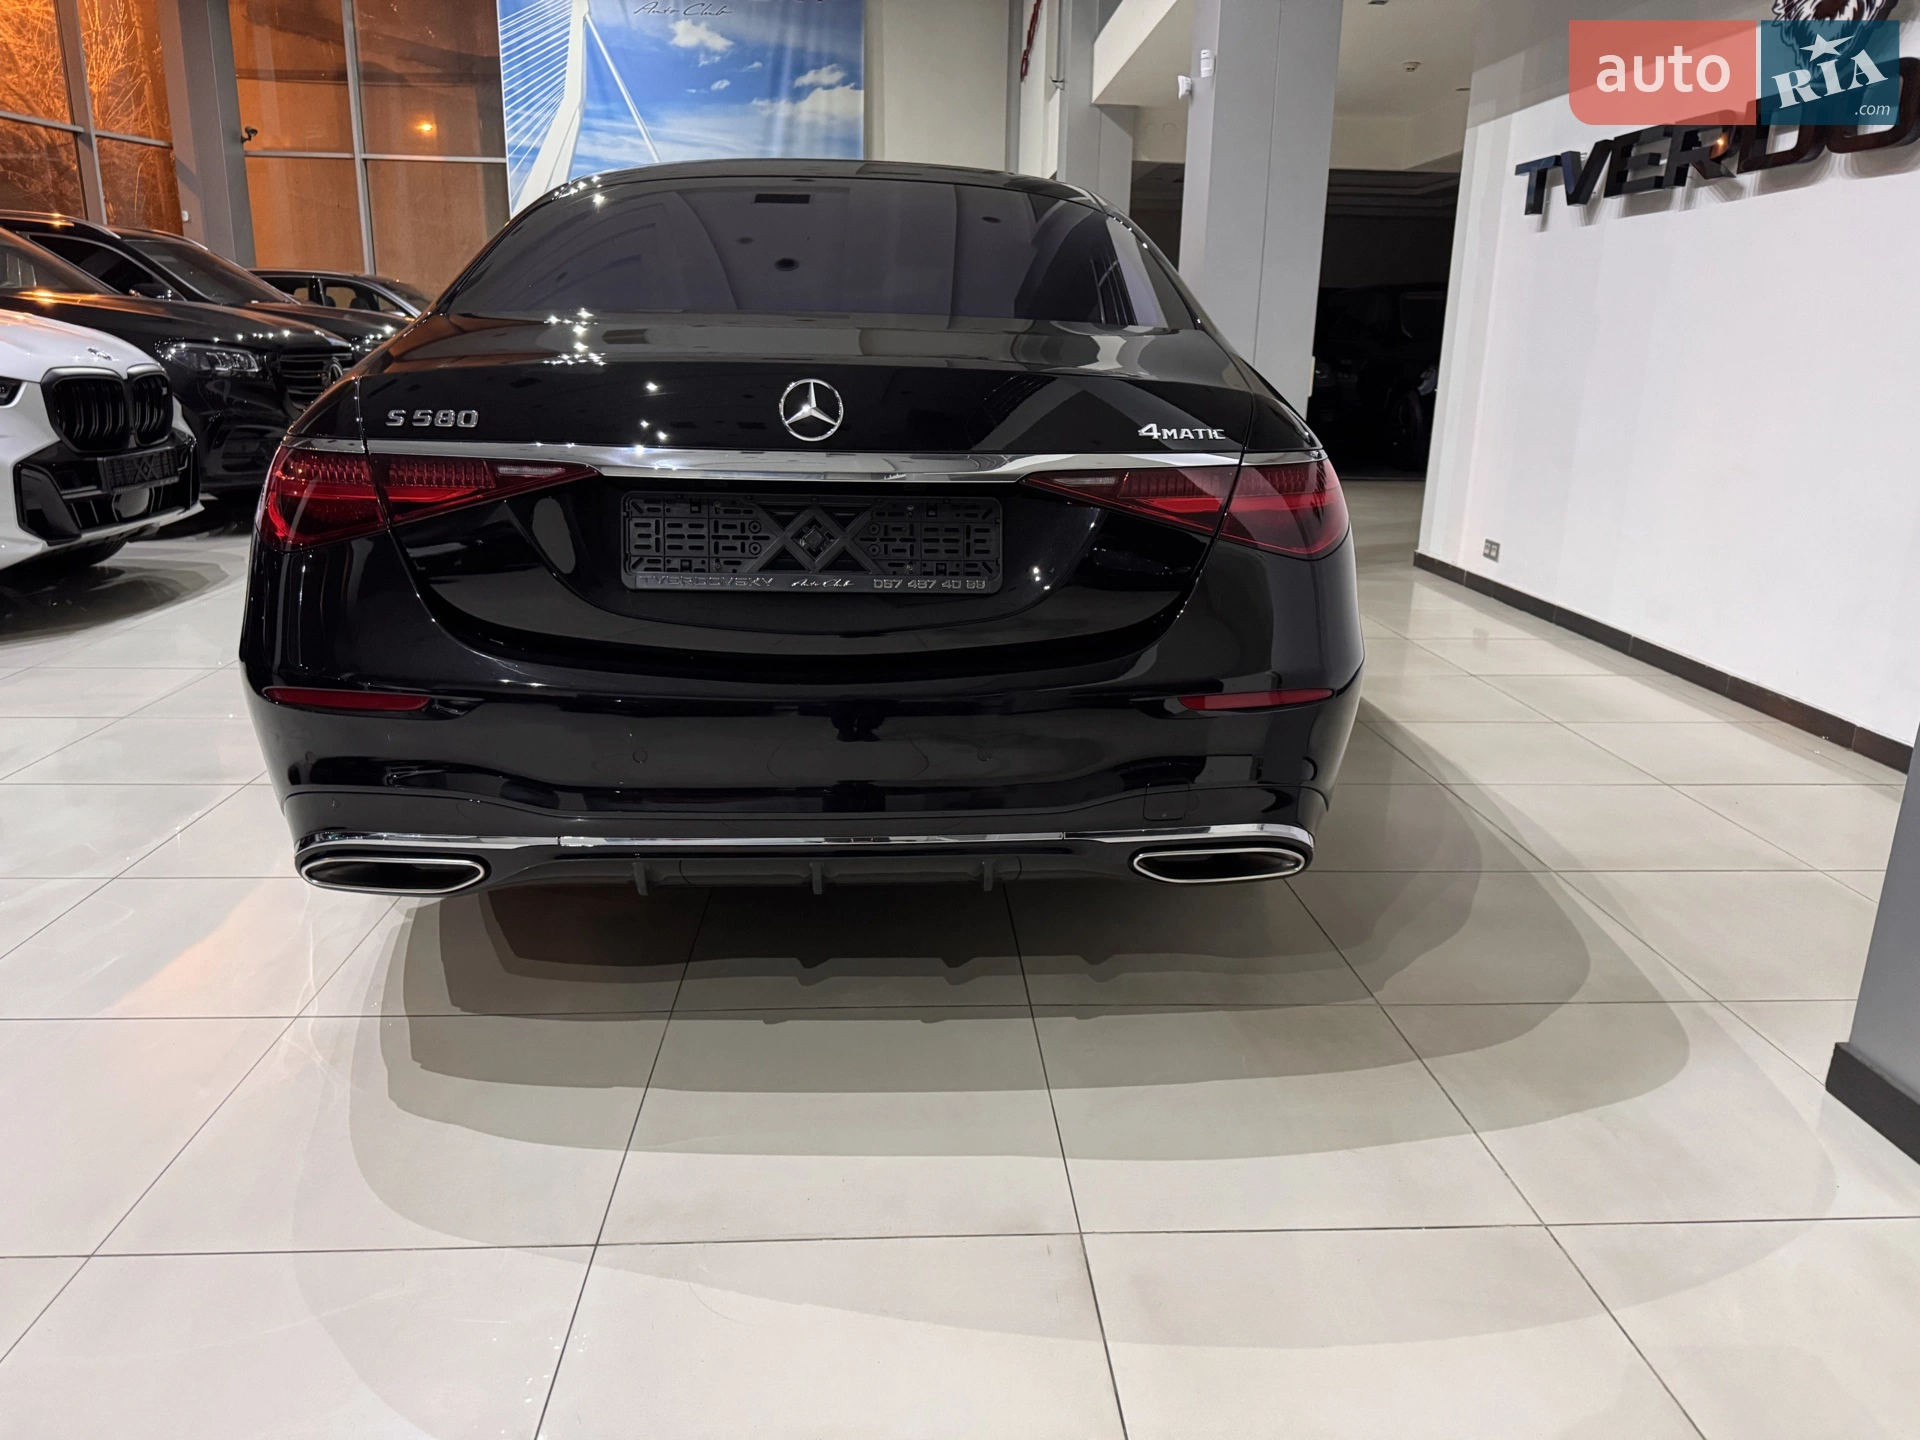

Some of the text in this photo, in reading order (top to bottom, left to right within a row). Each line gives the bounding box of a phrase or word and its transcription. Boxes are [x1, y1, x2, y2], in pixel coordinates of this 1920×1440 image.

[633, 1, 732, 16] Auto Club
[385, 409, 479, 428] S 580
[1138, 423, 1226, 440] 4MATIC
[873, 579, 903, 589] 067
[941, 579, 962, 589] 40
